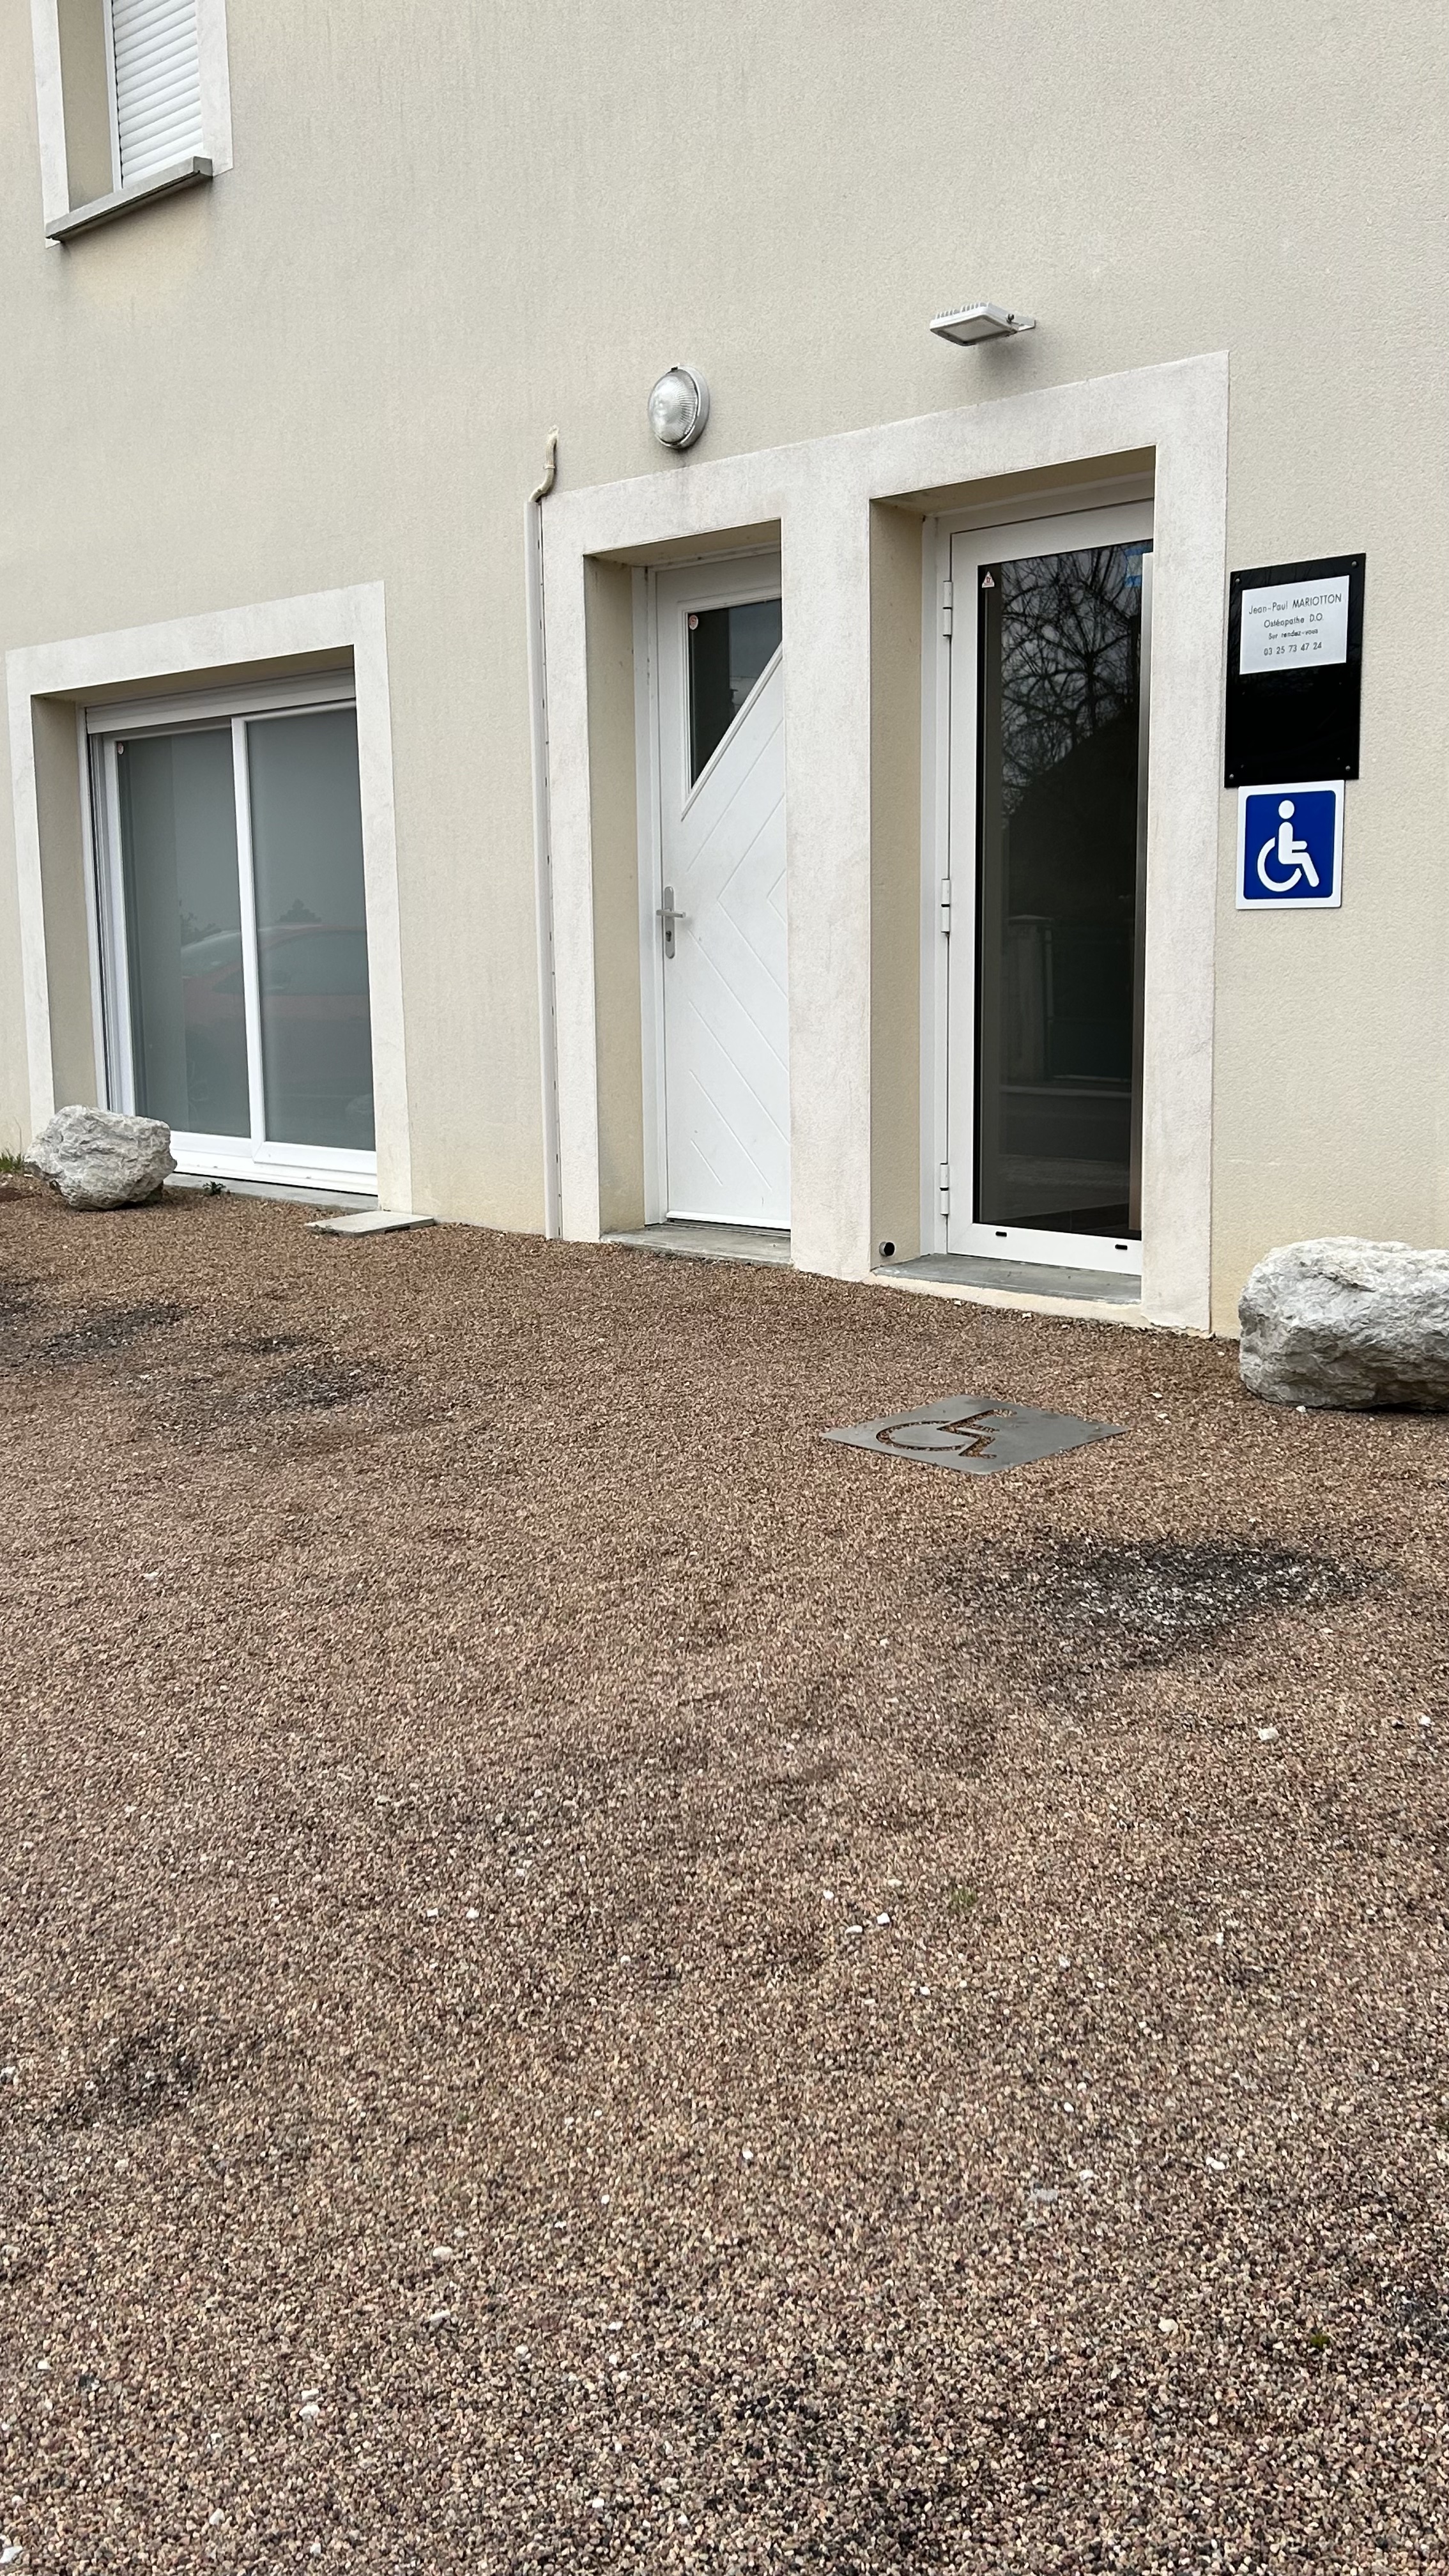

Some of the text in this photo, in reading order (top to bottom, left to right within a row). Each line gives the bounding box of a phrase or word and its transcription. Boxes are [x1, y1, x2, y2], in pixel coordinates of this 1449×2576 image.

[1249, 593, 1342, 615] Jean-Paul MARIOTTON
[1264, 641, 1322, 656] 03 25 73 47 24
